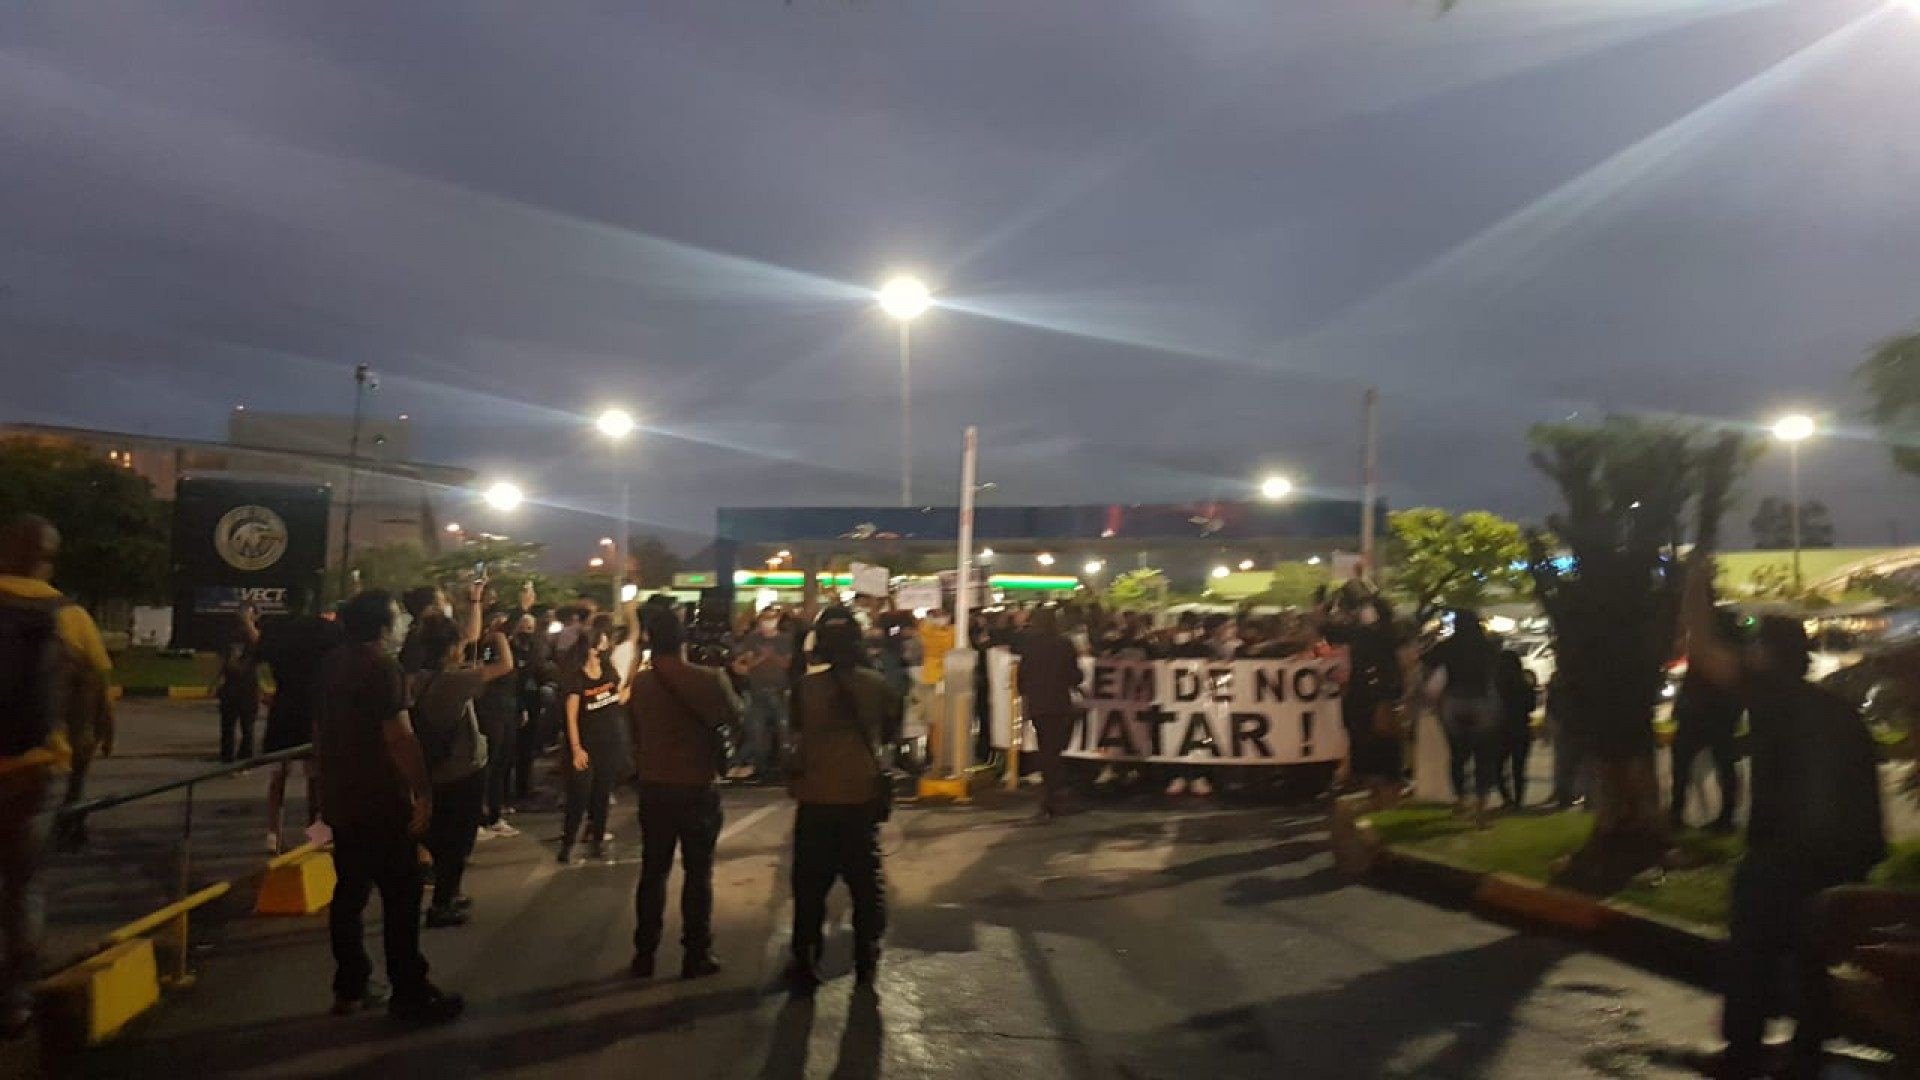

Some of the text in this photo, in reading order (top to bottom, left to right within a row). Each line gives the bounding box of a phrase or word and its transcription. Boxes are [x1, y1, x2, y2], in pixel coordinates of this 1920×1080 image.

[1076, 664, 1344, 704] EM DE NOS
[1301, 711, 1313, 758] !
